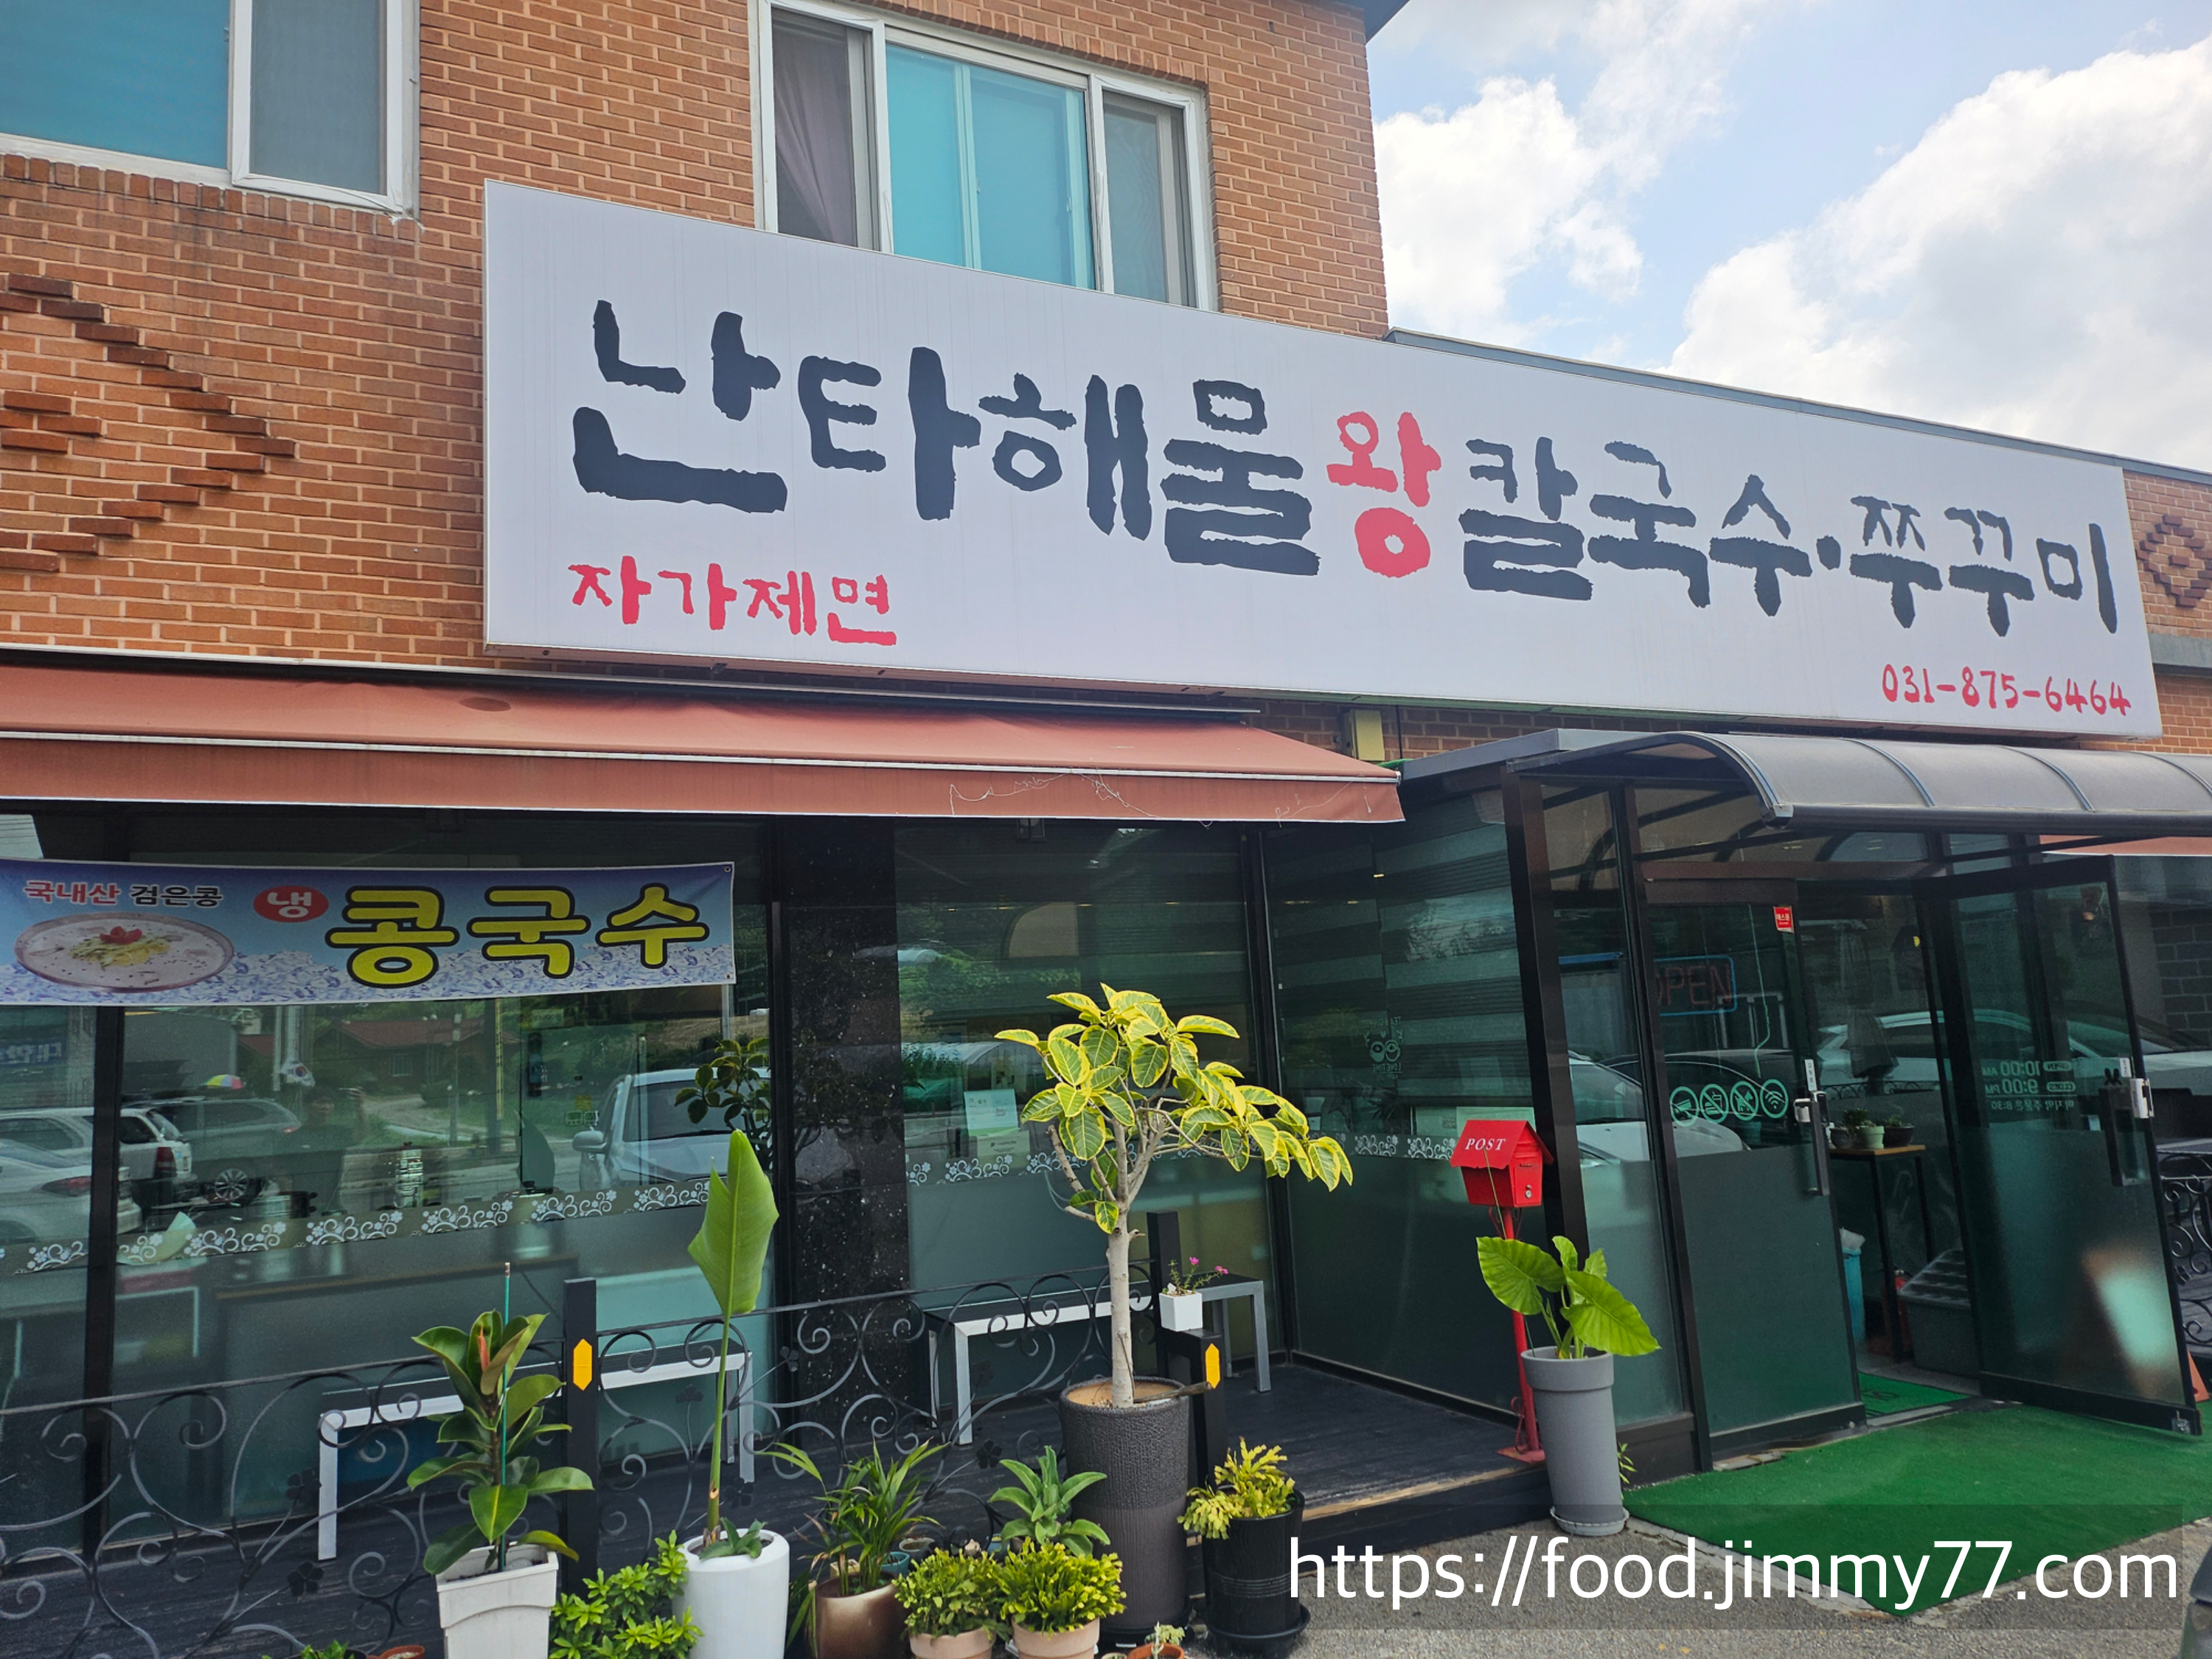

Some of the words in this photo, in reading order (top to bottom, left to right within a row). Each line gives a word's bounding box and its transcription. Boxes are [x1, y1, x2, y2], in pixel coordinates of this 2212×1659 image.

[568, 555, 897, 646] 자가제면
[1882, 664, 2131, 715] 031-875-6464
[24, 880, 121, 905] 국내산
[130, 884, 223, 908] 검은콩
[265, 890, 313, 919] 냉
[326, 884, 709, 987] 콩국수
[1464, 1138, 1506, 1151] POST
